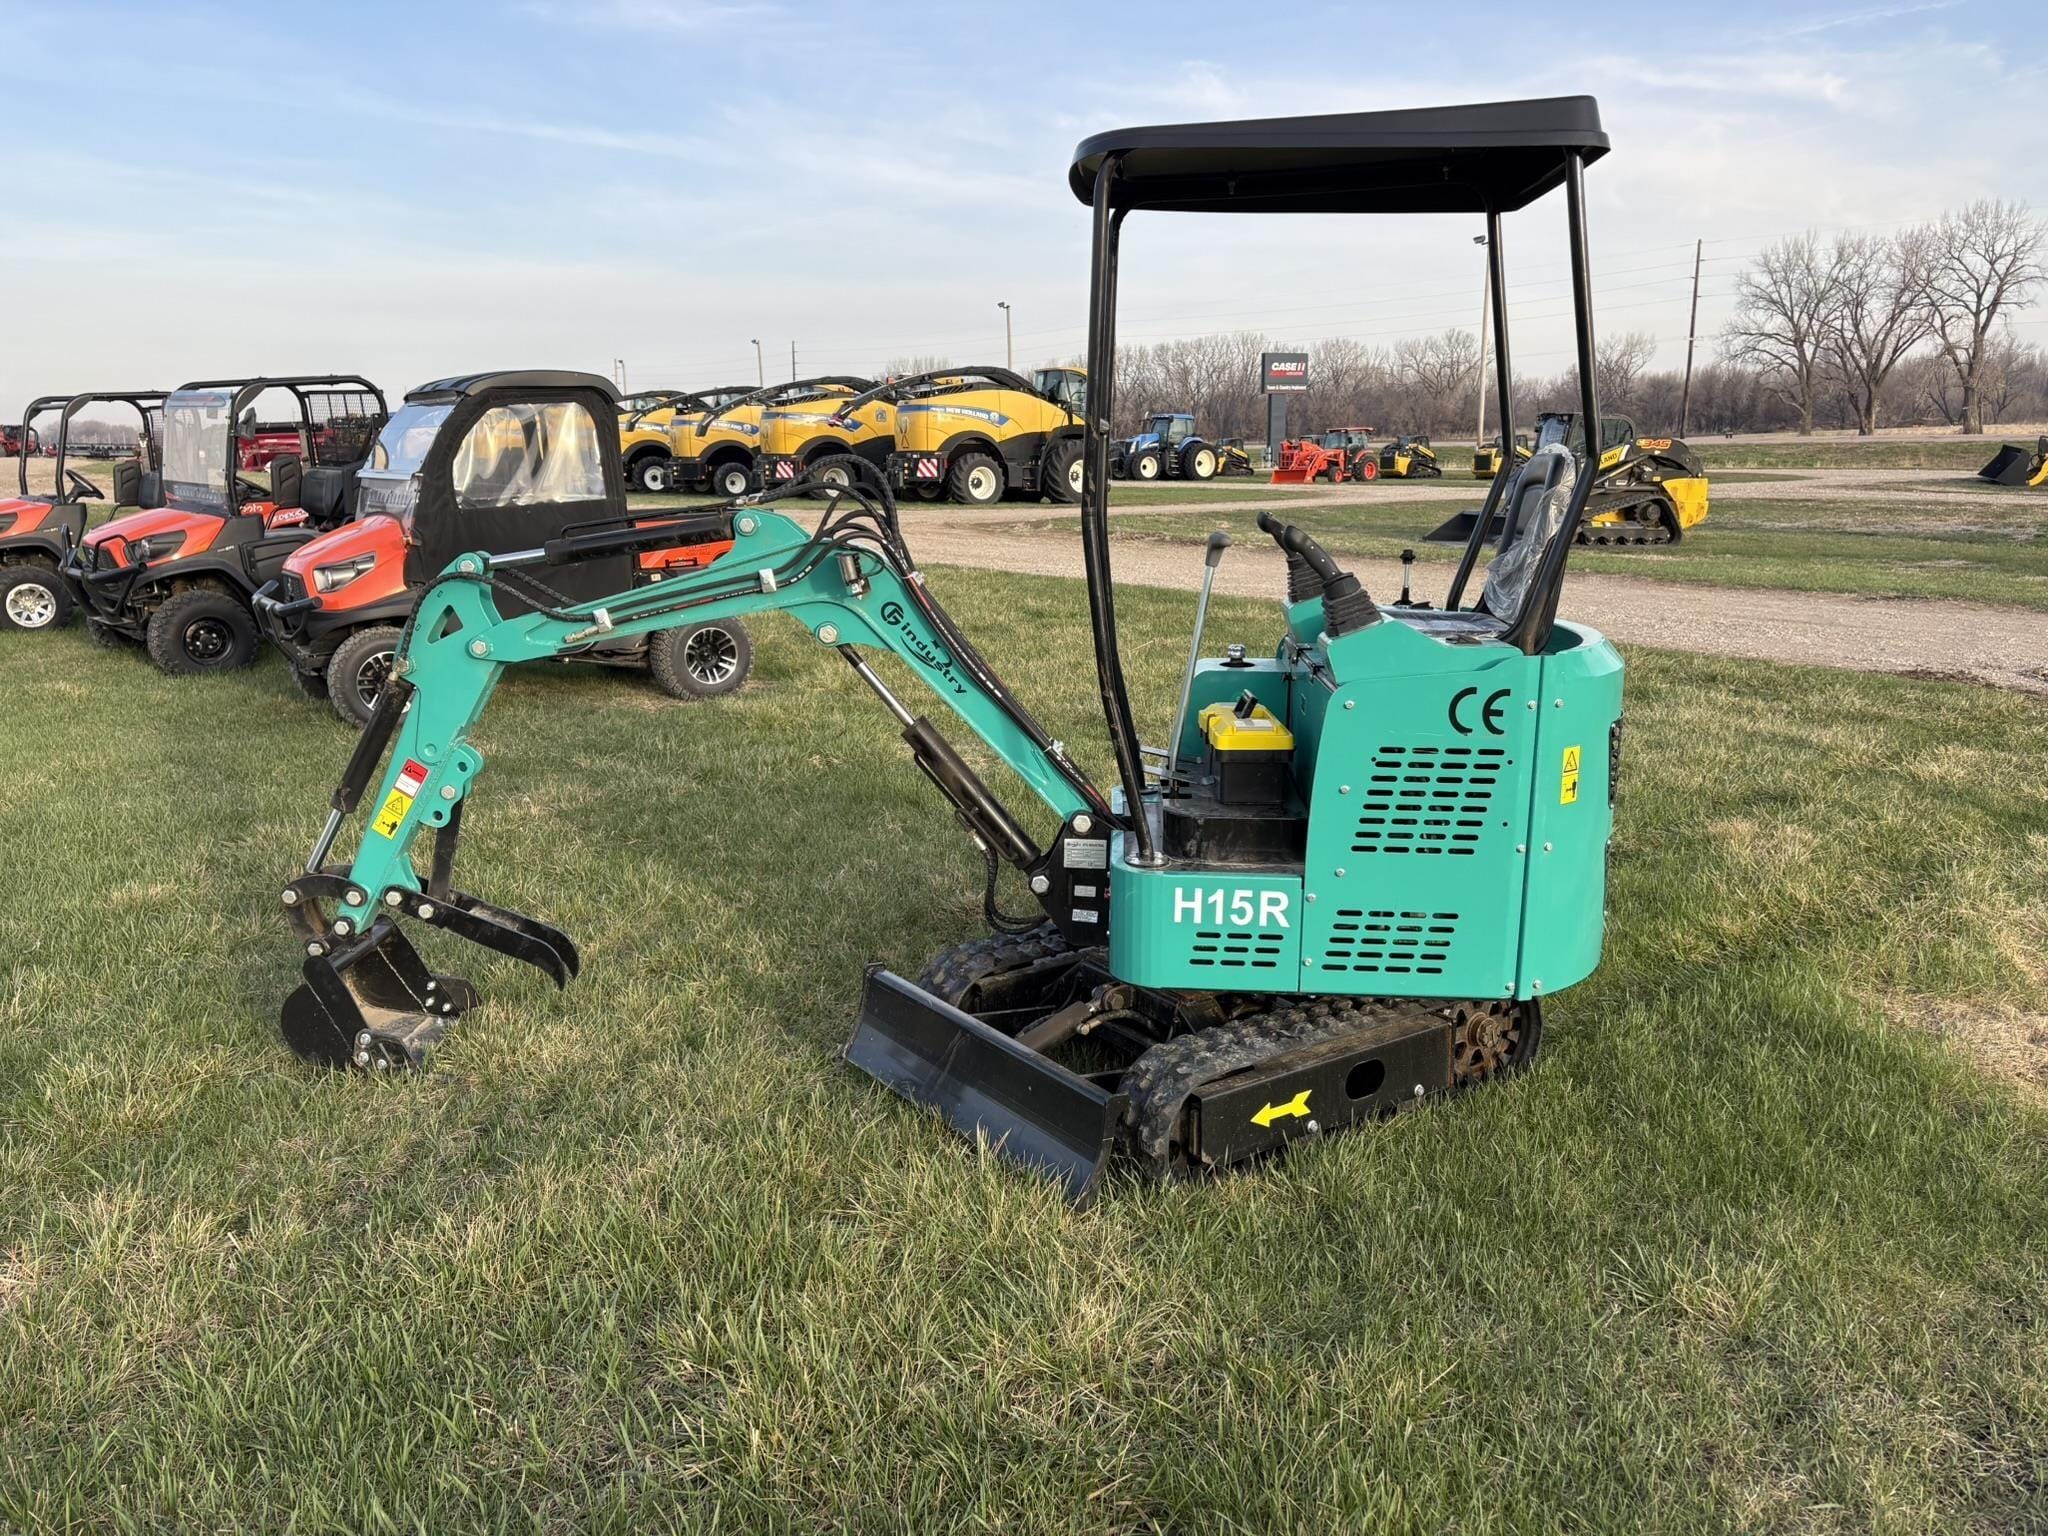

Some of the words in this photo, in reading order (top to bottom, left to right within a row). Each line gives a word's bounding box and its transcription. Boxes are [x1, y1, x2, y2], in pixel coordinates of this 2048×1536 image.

[1271, 362, 1297, 371] CASE
[961, 408, 989, 419] HOLLAND
[1600, 452, 1618, 464] LAND
[1448, 686, 1511, 736] CE
[1174, 887, 1290, 928] H15R
